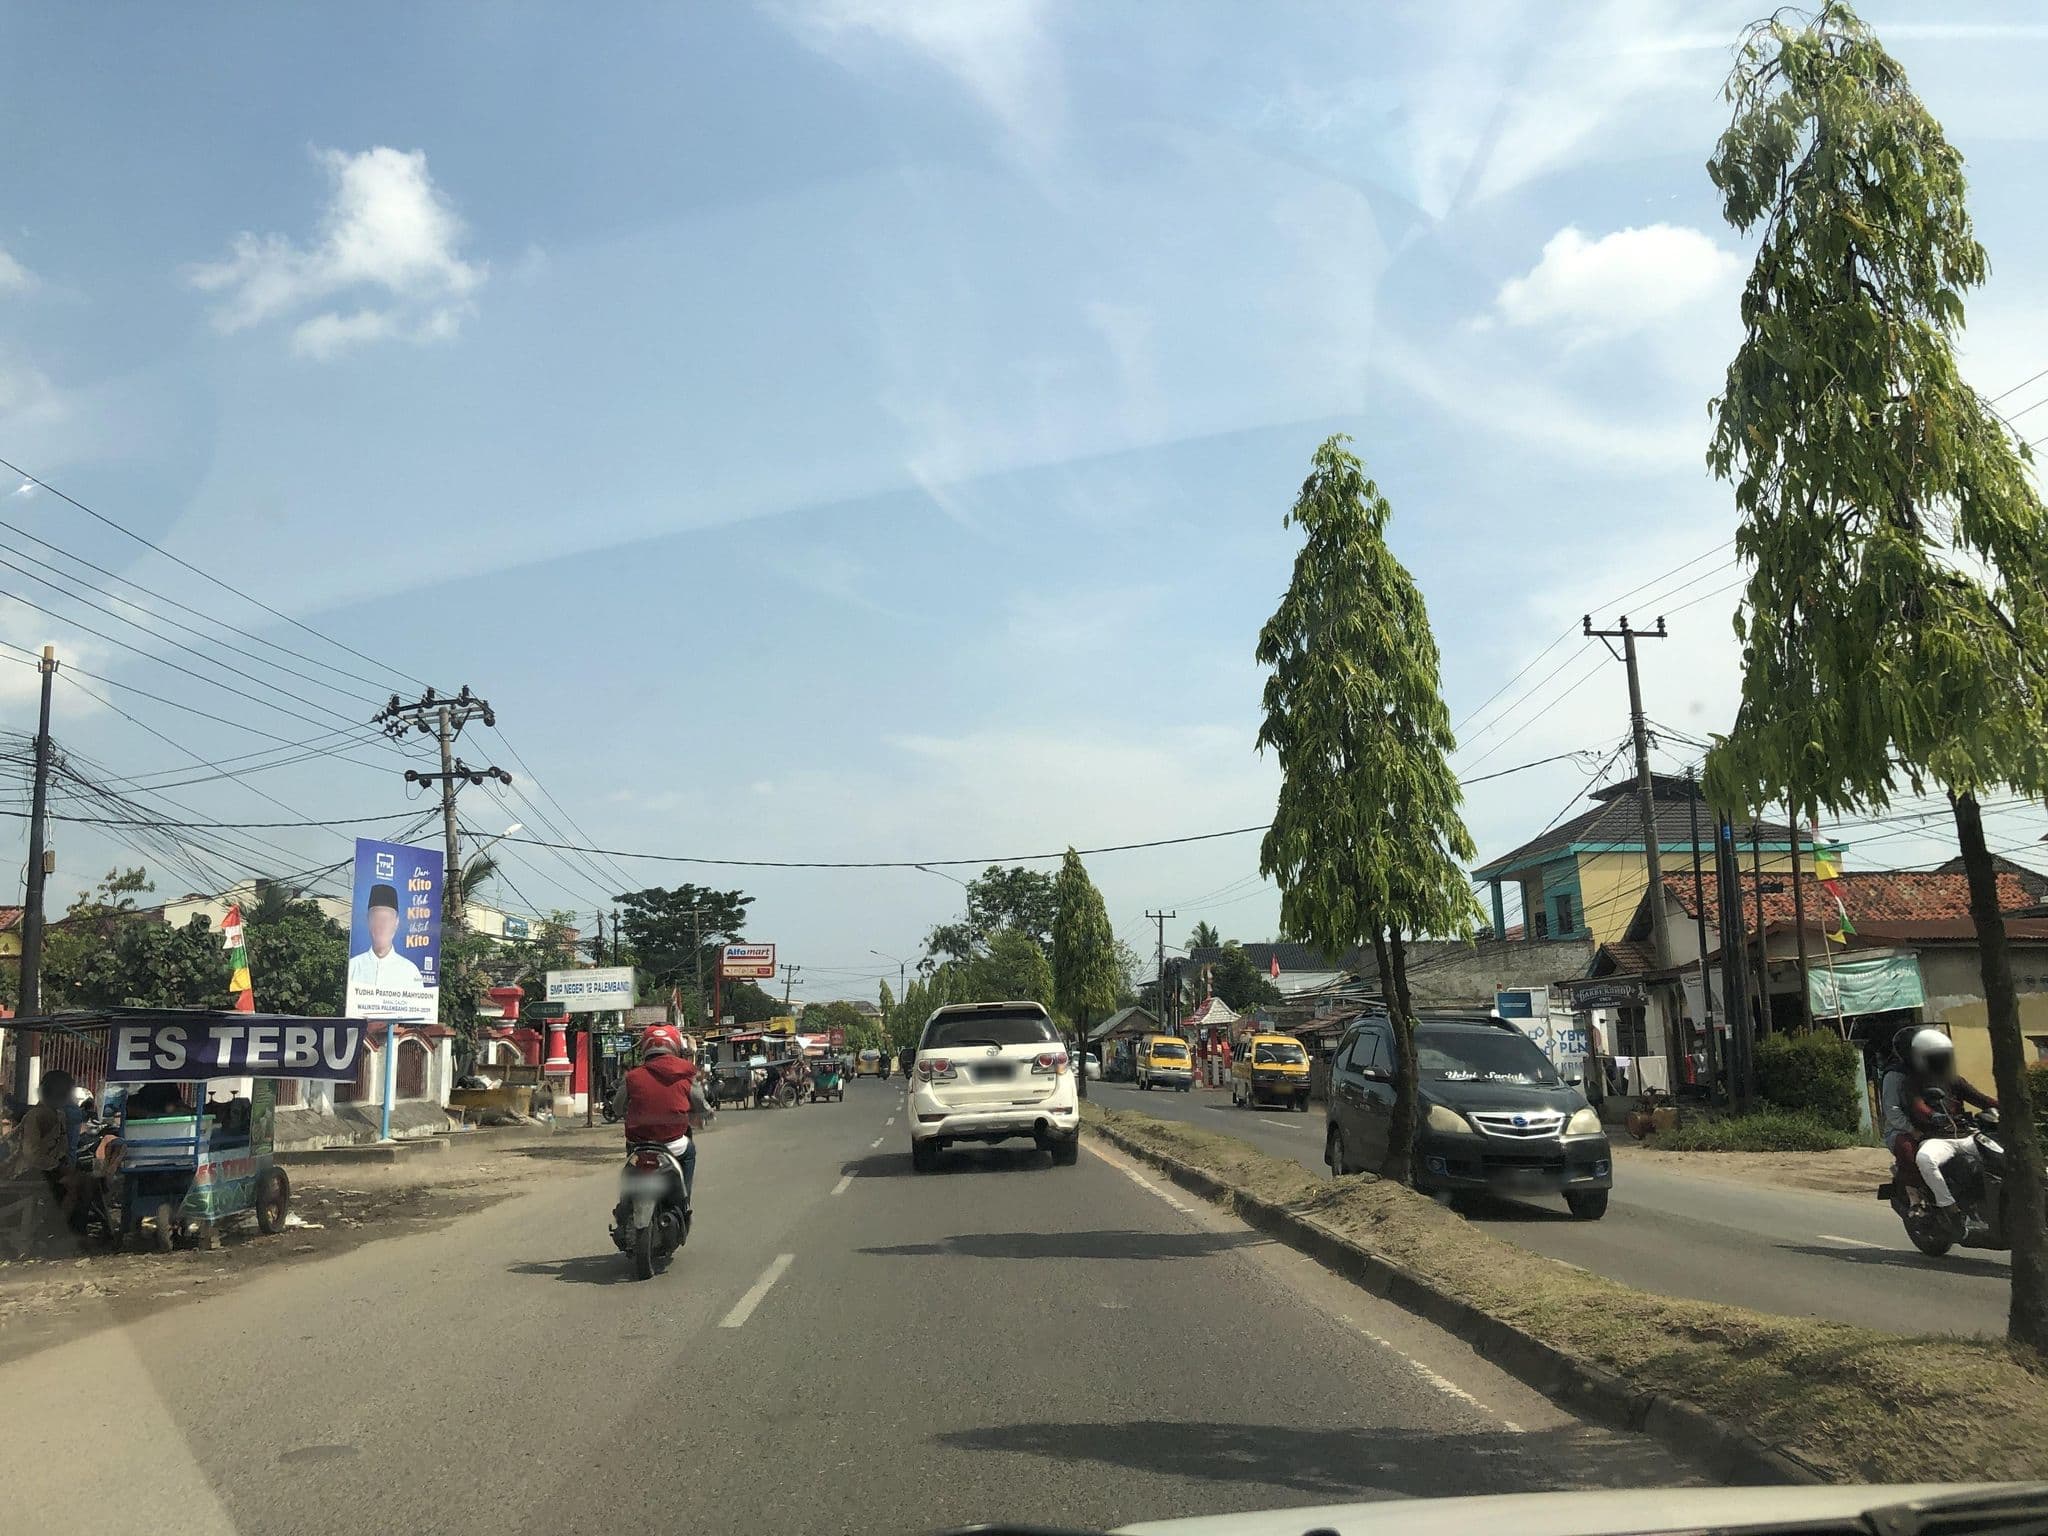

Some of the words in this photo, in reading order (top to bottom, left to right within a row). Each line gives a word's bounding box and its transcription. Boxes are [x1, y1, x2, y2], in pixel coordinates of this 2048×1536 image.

[409, 879, 431, 891] Kito
[408, 907, 430, 919] Kito
[406, 934, 429, 948] Kito
[354, 988, 374, 996] YUDHA
[375, 989, 401, 998] PRATOMO
[550, 984, 563, 995] SMP
[564, 982, 585, 995] NEGERI
[586, 982, 593, 993] 12
[594, 981, 630, 993] PALEMBANG
[1556, 1030, 1587, 1041] YBM
[116, 1027, 188, 1071] ES
[208, 1027, 359, 1070] TEBU
[1560, 1042, 1589, 1054] PLN
